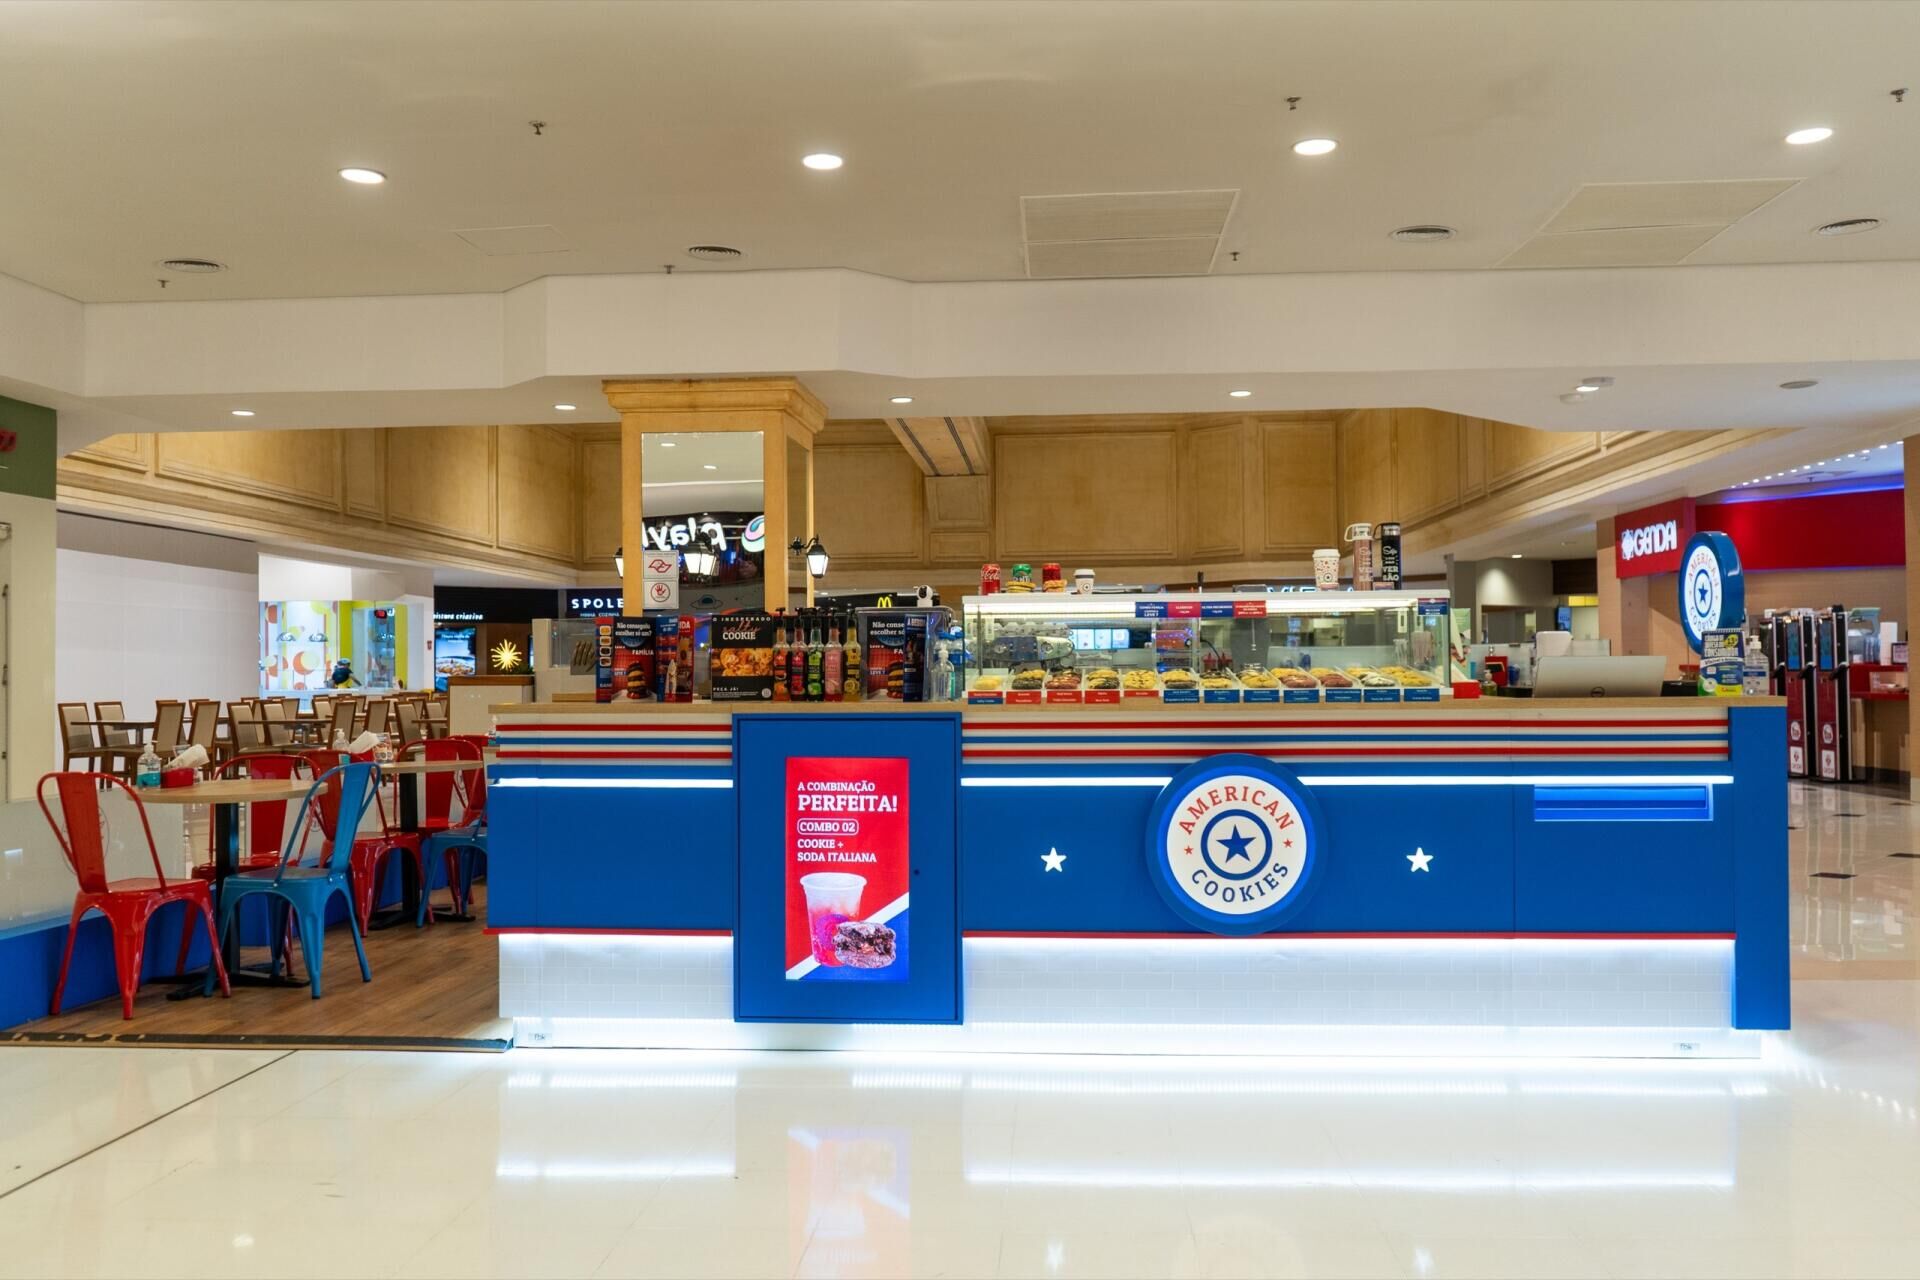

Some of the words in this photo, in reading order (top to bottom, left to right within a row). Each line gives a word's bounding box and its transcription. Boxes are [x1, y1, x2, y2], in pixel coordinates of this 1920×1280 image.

[571, 598, 624, 609] SPOLE
[722, 631, 756, 640] COOKIE
[632, 648, 654, 656] FAMÍLIA
[797, 781, 806, 791] A
[807, 780, 876, 793] COMBINAÇÃO
[797, 794, 898, 812] PERFEITA!
[1179, 786, 1294, 835] AMERICAN
[799, 822, 840, 832] COMBO
[842, 822, 856, 832] 02
[797, 839, 836, 849] COOKIE
[797, 852, 825, 862] SODA
[827, 852, 877, 862] ITALIANA
[1191, 862, 1289, 903] COOKIES
